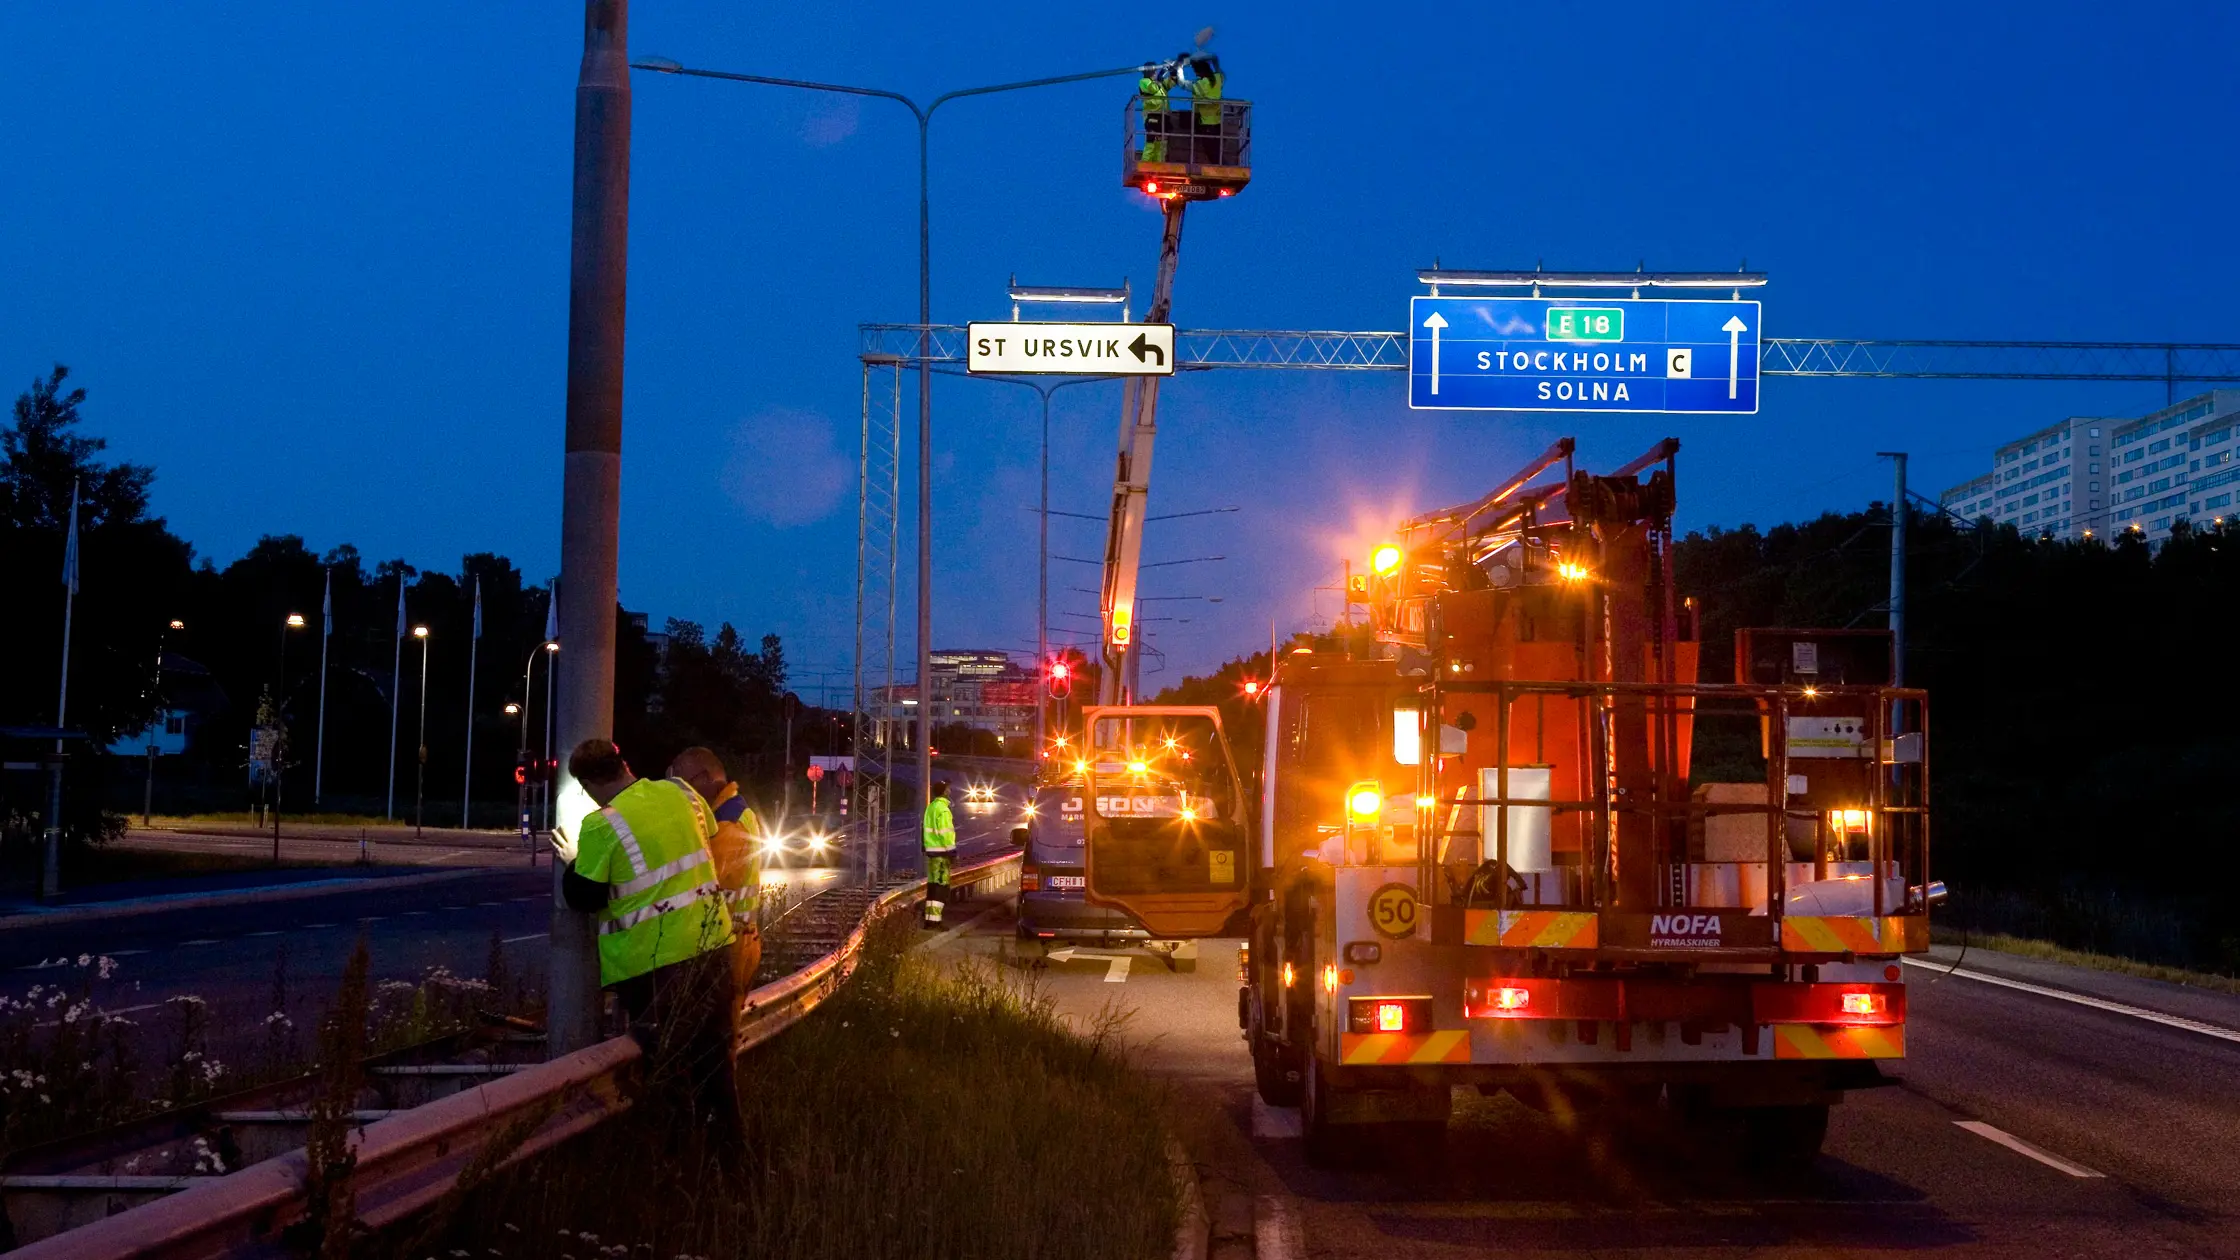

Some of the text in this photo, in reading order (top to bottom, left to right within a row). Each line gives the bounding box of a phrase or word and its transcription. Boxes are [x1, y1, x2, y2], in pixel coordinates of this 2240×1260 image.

[1559, 315, 1610, 334] E 18
[977, 338, 1120, 358] ST URSVIK
[1477, 351, 1685, 373] STOCKHOLM C
[1537, 381, 1631, 402] SOLNA
[1604, 594, 1612, 676] NOFA
[1053, 876, 1071, 886] CFH
[1379, 898, 1415, 924] 50
[1650, 914, 1722, 935] NOFA
[1650, 938, 1721, 947] HYRMASKINER
